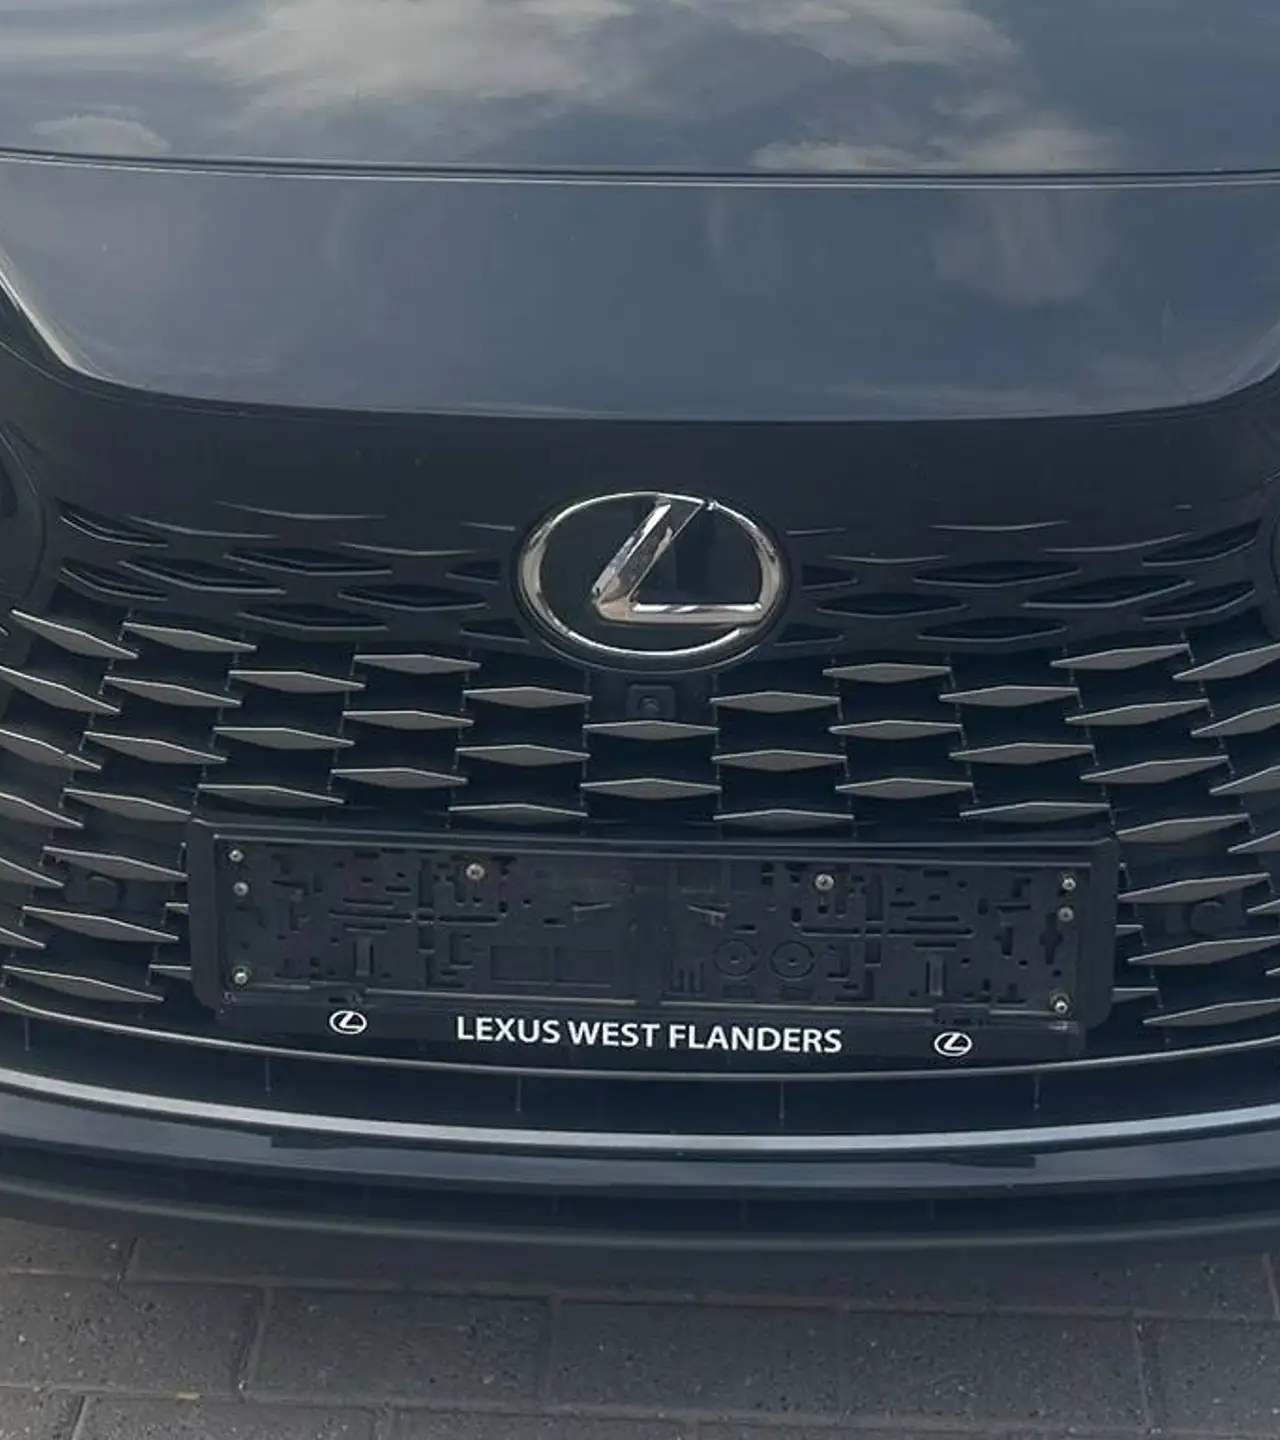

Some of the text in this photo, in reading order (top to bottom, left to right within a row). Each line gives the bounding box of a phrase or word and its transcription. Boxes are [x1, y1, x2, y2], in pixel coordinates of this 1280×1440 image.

[457, 1016, 843, 1054] LEXUS WEST FLANDERS
